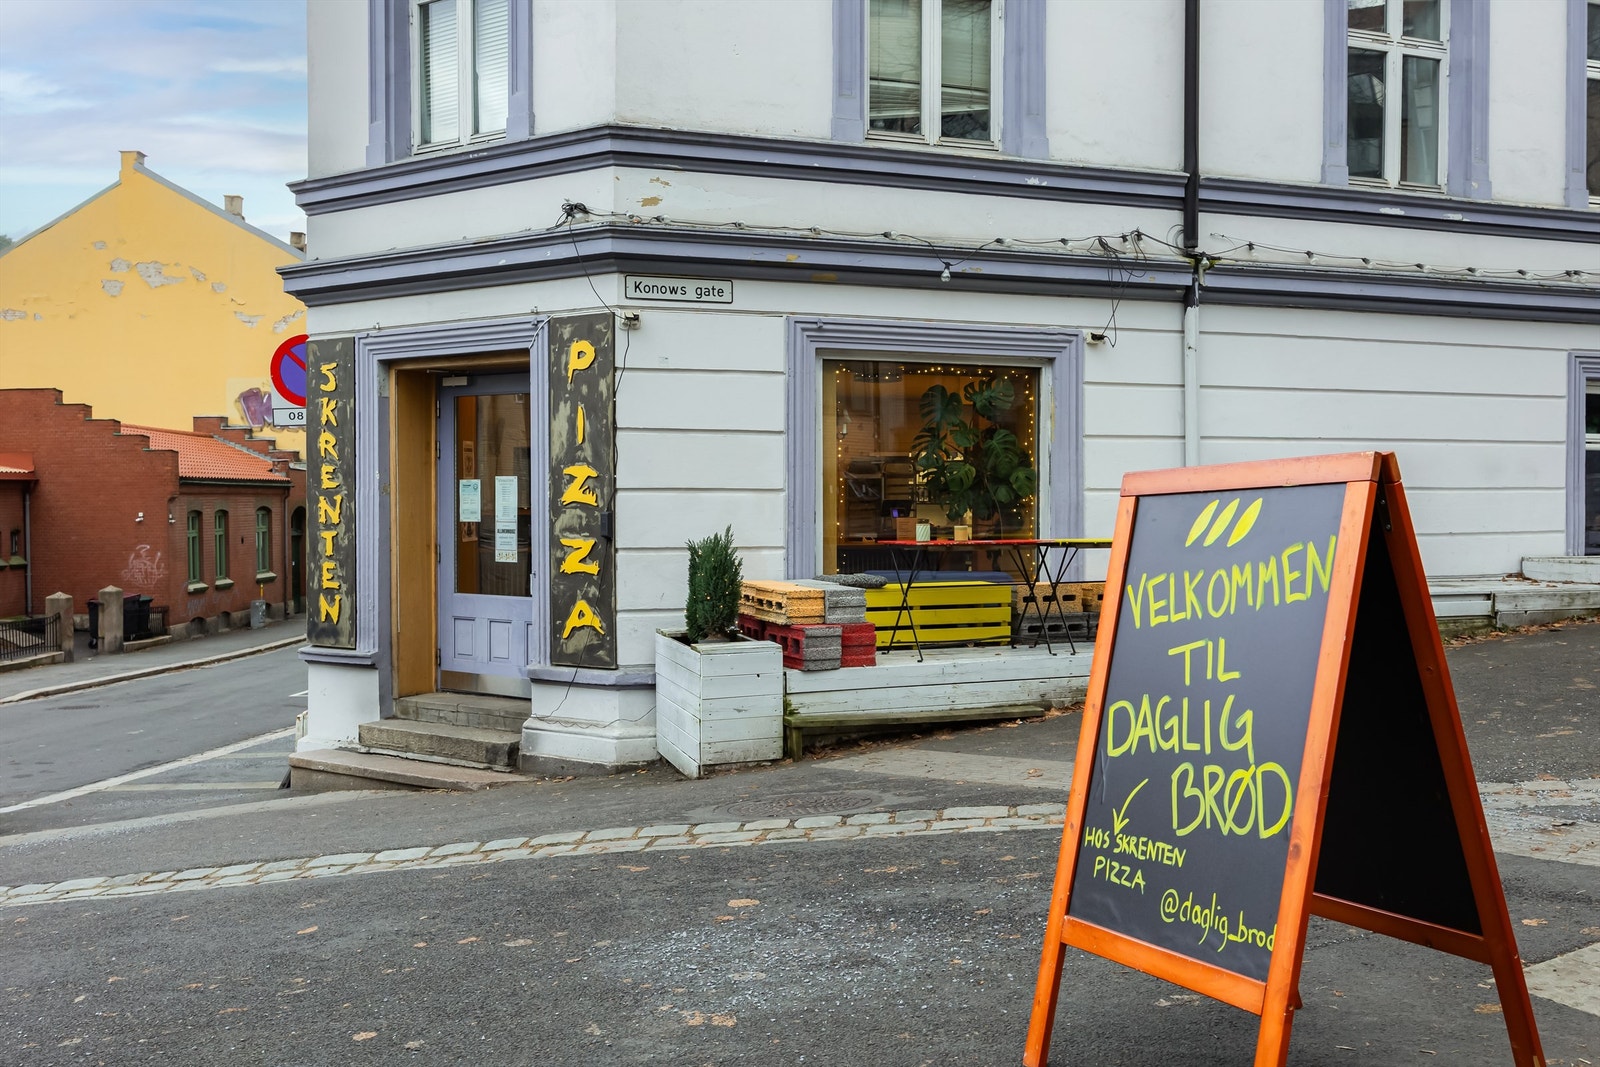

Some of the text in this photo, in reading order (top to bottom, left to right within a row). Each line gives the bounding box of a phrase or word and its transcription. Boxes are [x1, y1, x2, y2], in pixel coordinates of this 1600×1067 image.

[634, 281, 725, 299] Konows gate
[288, 411, 304, 421] 08
[317, 362, 343, 625] SKRENTEN
[560, 339, 605, 639] PIZZA
[1127, 535, 1337, 629] VELKOMMEN
[1168, 637, 1241, 686] TIL
[1107, 694, 1254, 764] DAGLIG
[1171, 762, 1292, 839] BRØD
[1084, 826, 1186, 868] HOS SKRENTEN
[1093, 855, 1146, 895] PIZZA
